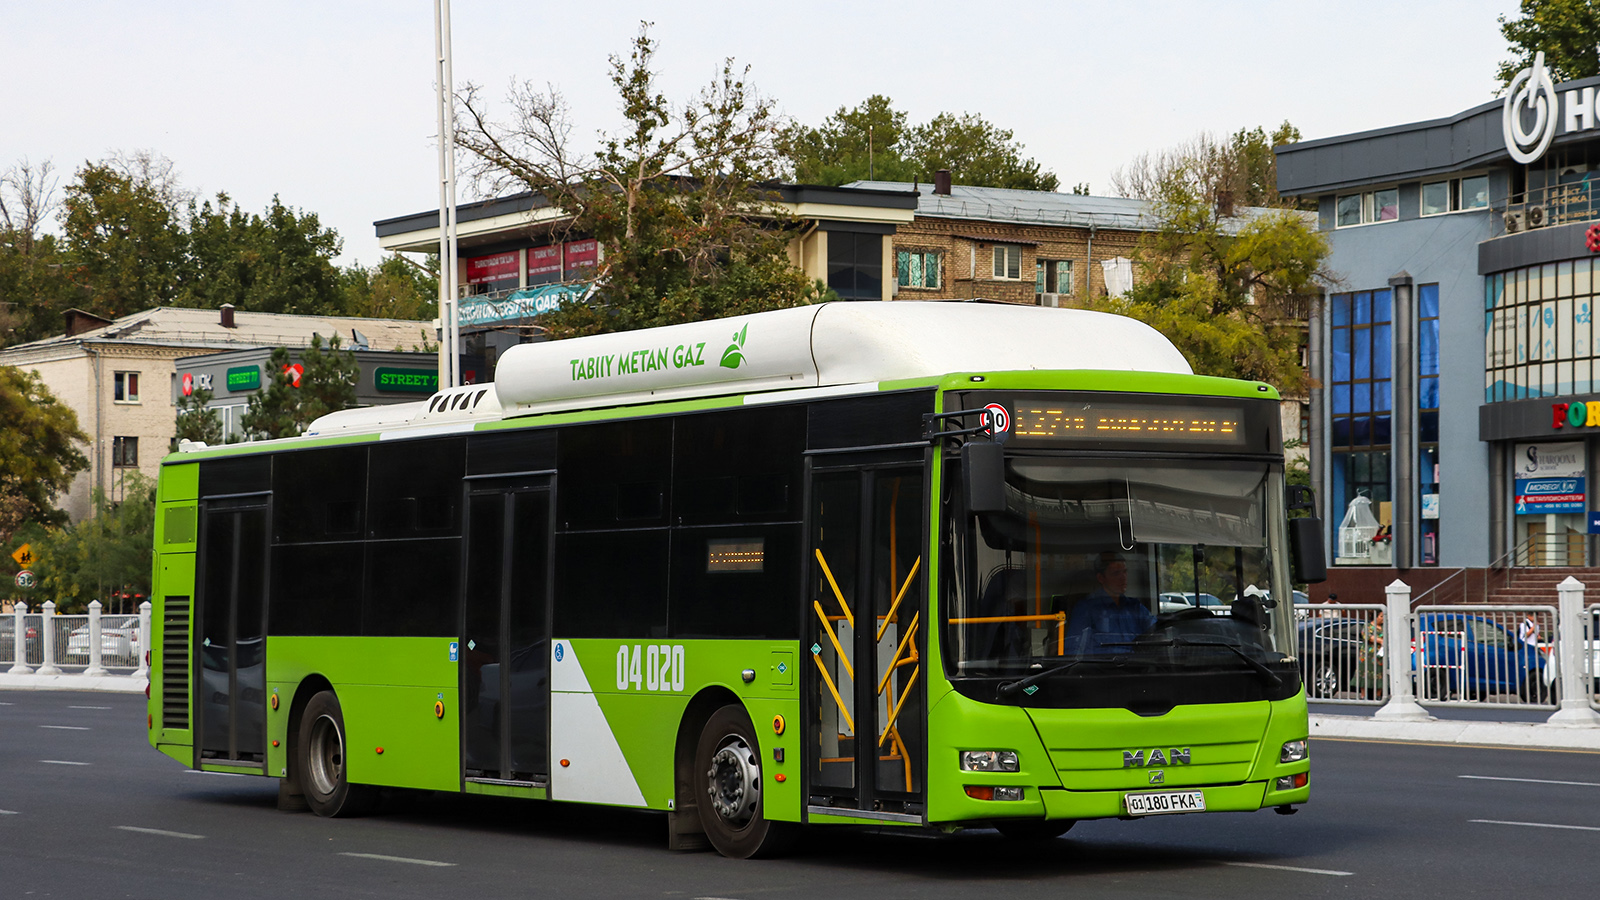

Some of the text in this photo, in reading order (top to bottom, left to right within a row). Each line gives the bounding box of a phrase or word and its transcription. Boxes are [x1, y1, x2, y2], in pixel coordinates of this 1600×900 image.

[1565, 87, 1600, 132] H
[570, 342, 706, 381] TABIIY METAN GAZ
[228, 371, 258, 385] STREET 77
[381, 374, 438, 386] STREET 7
[617, 645, 685, 692] 04 020
[1122, 747, 1191, 768] MAN
[1132, 794, 1197, 811] 01 180 FKA
